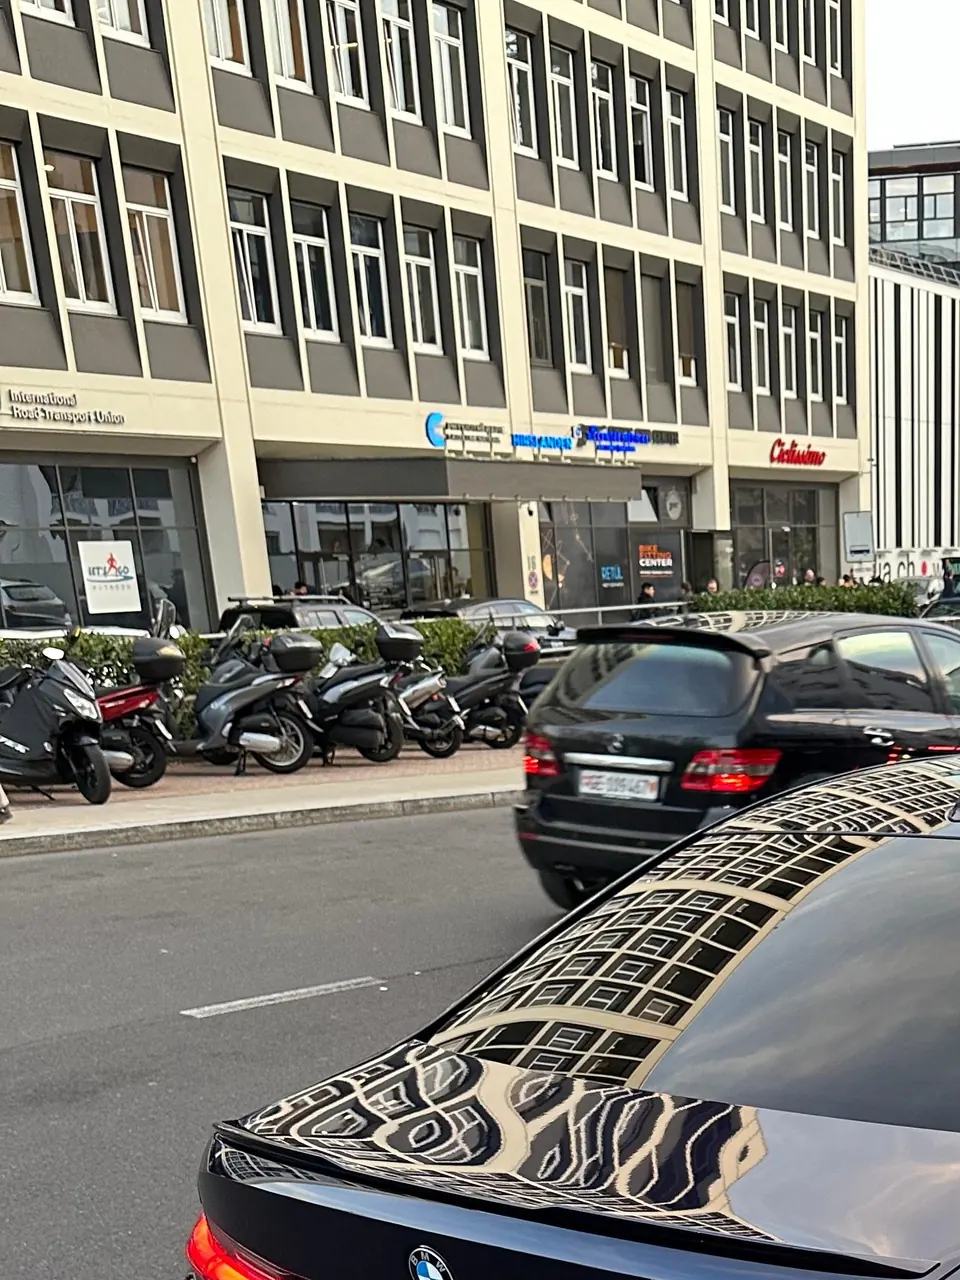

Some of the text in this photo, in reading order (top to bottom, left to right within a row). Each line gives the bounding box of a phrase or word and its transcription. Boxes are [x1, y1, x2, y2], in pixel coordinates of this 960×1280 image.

[8, 389, 78, 407] International
[11, 405, 126, 425] Road Transport Union
[638, 558, 673, 567] CENTER
[411, 1251, 446, 1272] BMW
